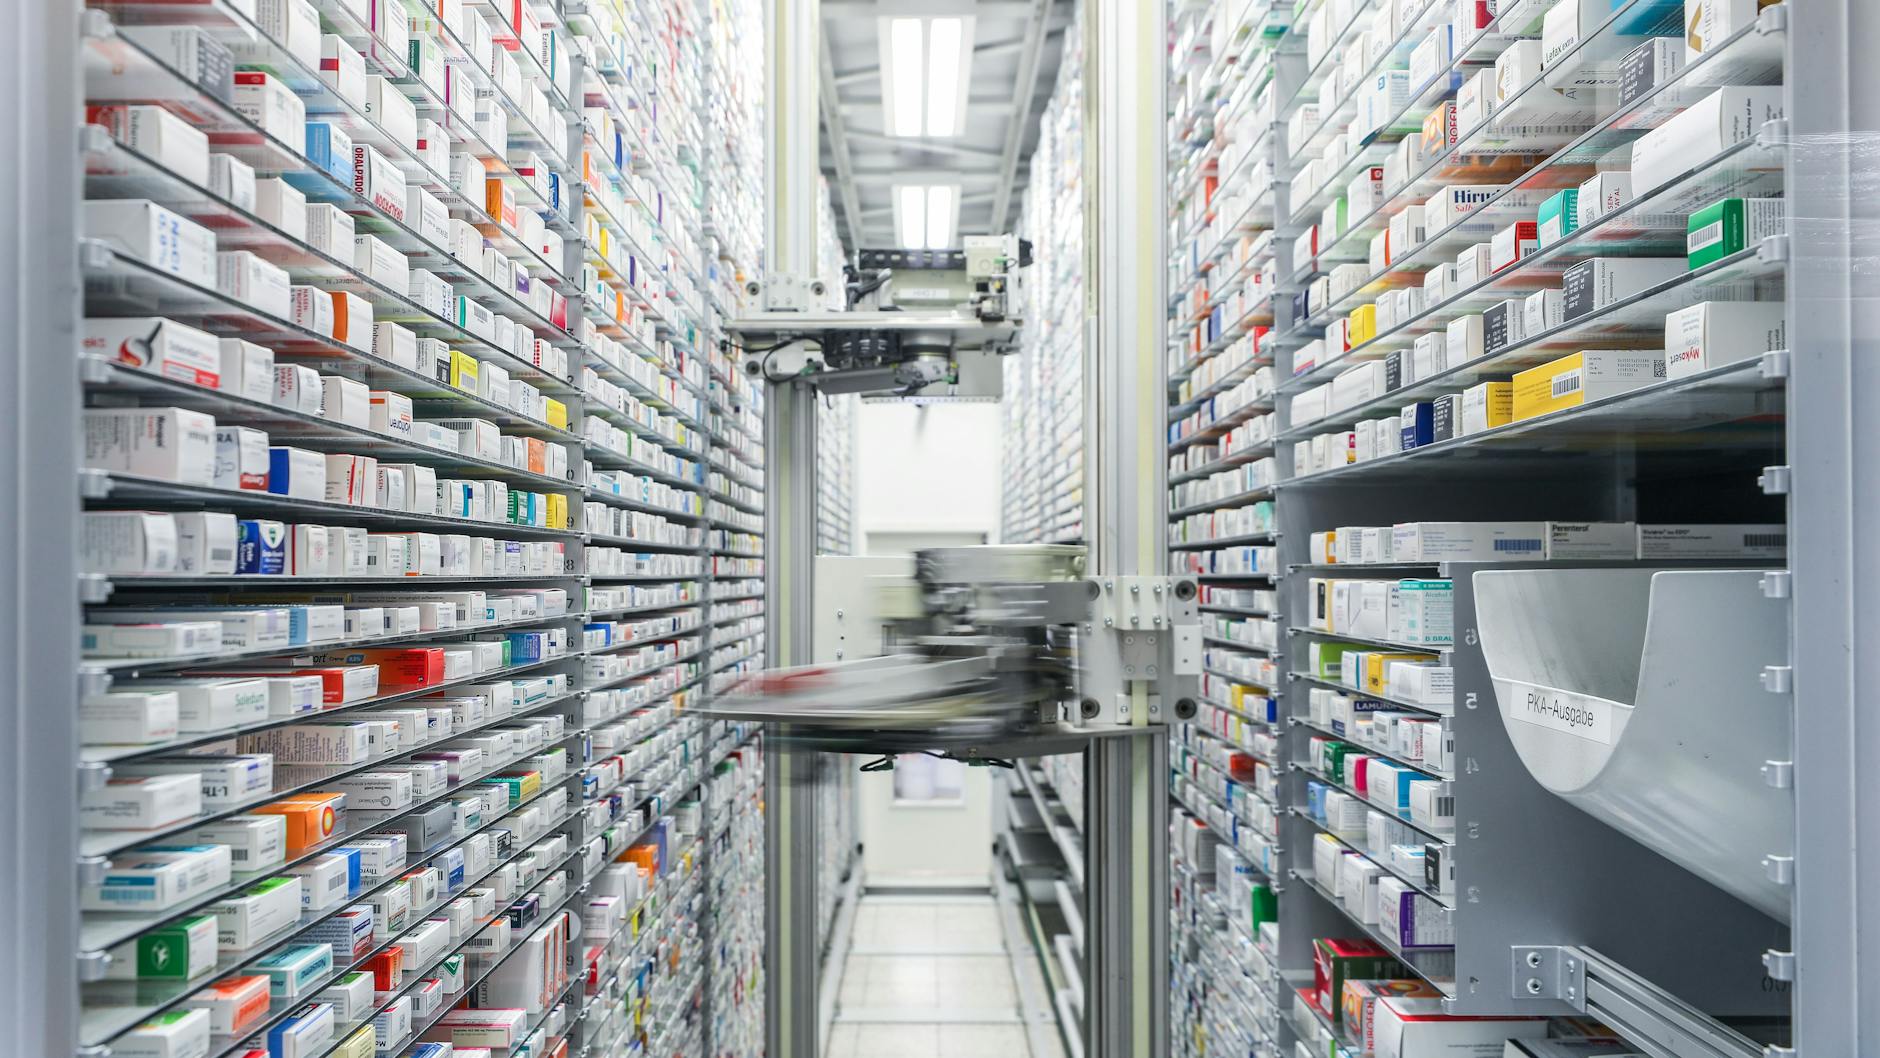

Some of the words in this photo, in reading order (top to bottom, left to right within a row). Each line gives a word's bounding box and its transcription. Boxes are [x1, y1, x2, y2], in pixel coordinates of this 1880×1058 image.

[1546, 42, 1562, 64] Lefax
[1562, 36, 1574, 52] extra
[1669, 348, 1700, 364] Mykosert
[1527, 694, 1594, 727] PKA-Ausgabe
